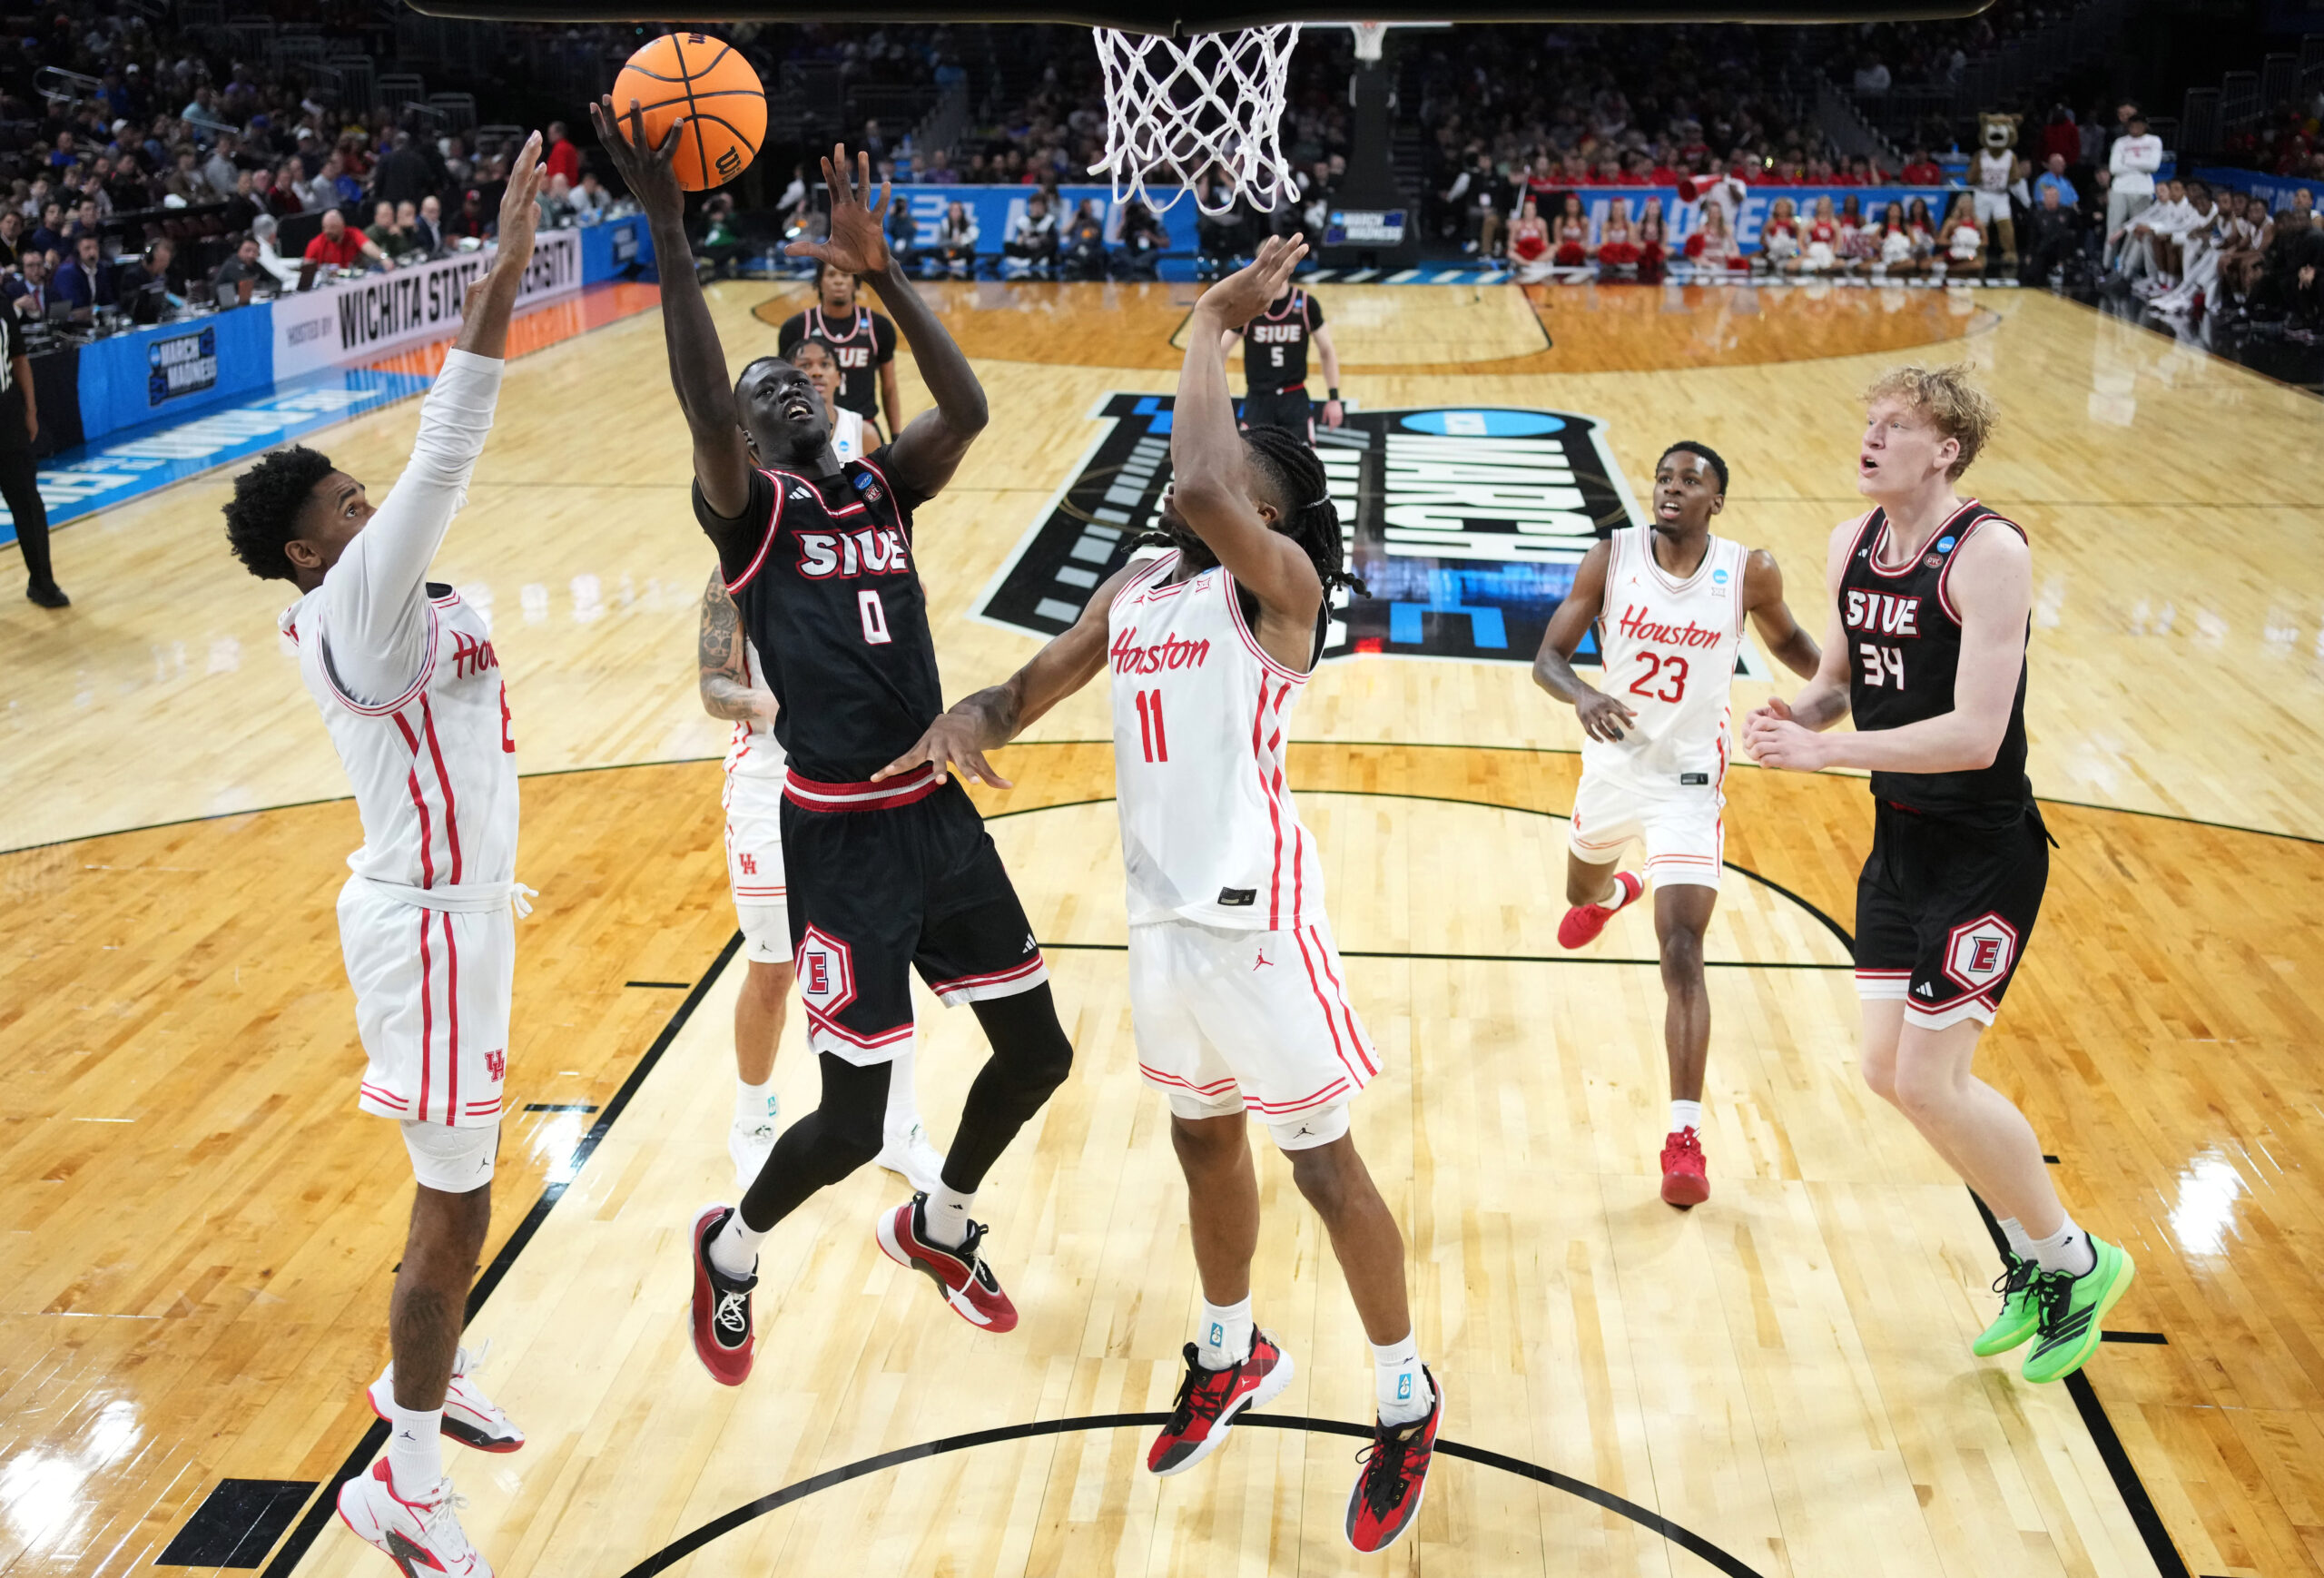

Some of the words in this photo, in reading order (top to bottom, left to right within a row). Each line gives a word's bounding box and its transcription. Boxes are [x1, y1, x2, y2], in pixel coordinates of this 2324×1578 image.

[339, 277, 422, 350] WICHITA
[1254, 324, 1302, 343] SIUE
[1271, 345, 1285, 368] 5
[1384, 433, 1598, 565] MARCH
[792, 525, 910, 580] SIUE
[857, 589, 892, 646] 0
[1620, 604, 1722, 650] Houston
[1845, 587, 1923, 639] SIUE
[1630, 650, 1689, 704] 23
[1859, 642, 1905, 691] 34
[1136, 688, 1168, 763] 11
[738, 853, 757, 875] UH
[806, 952, 829, 995] E
[1967, 936, 2003, 972] E
[484, 1048, 506, 1083] UH
